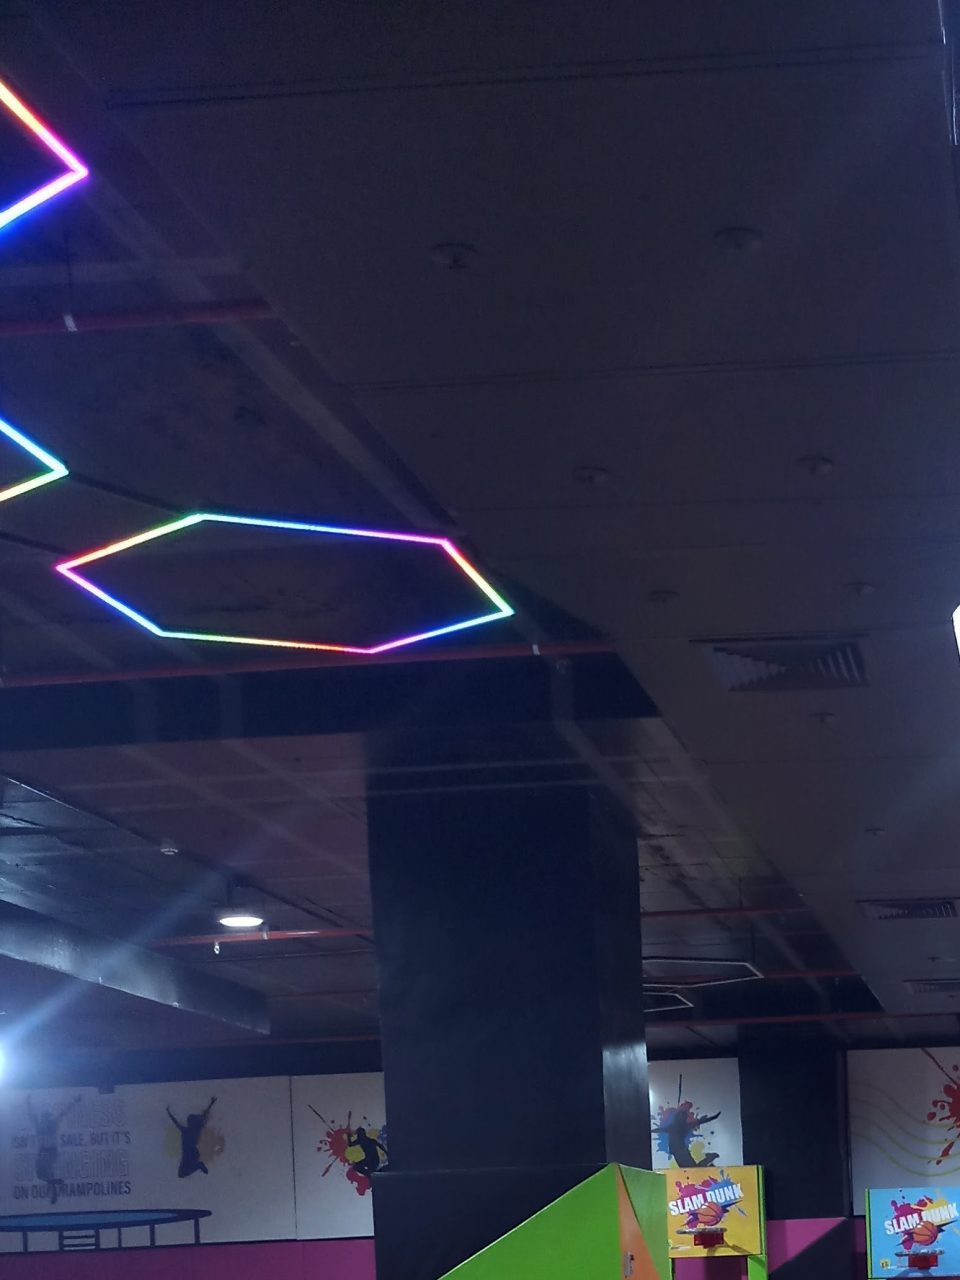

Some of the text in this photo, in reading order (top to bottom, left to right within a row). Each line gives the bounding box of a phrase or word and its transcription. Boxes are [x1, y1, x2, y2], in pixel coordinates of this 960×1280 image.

[668, 1183, 745, 1216] SLAM DUNK
[884, 1212, 920, 1236] SLAM
